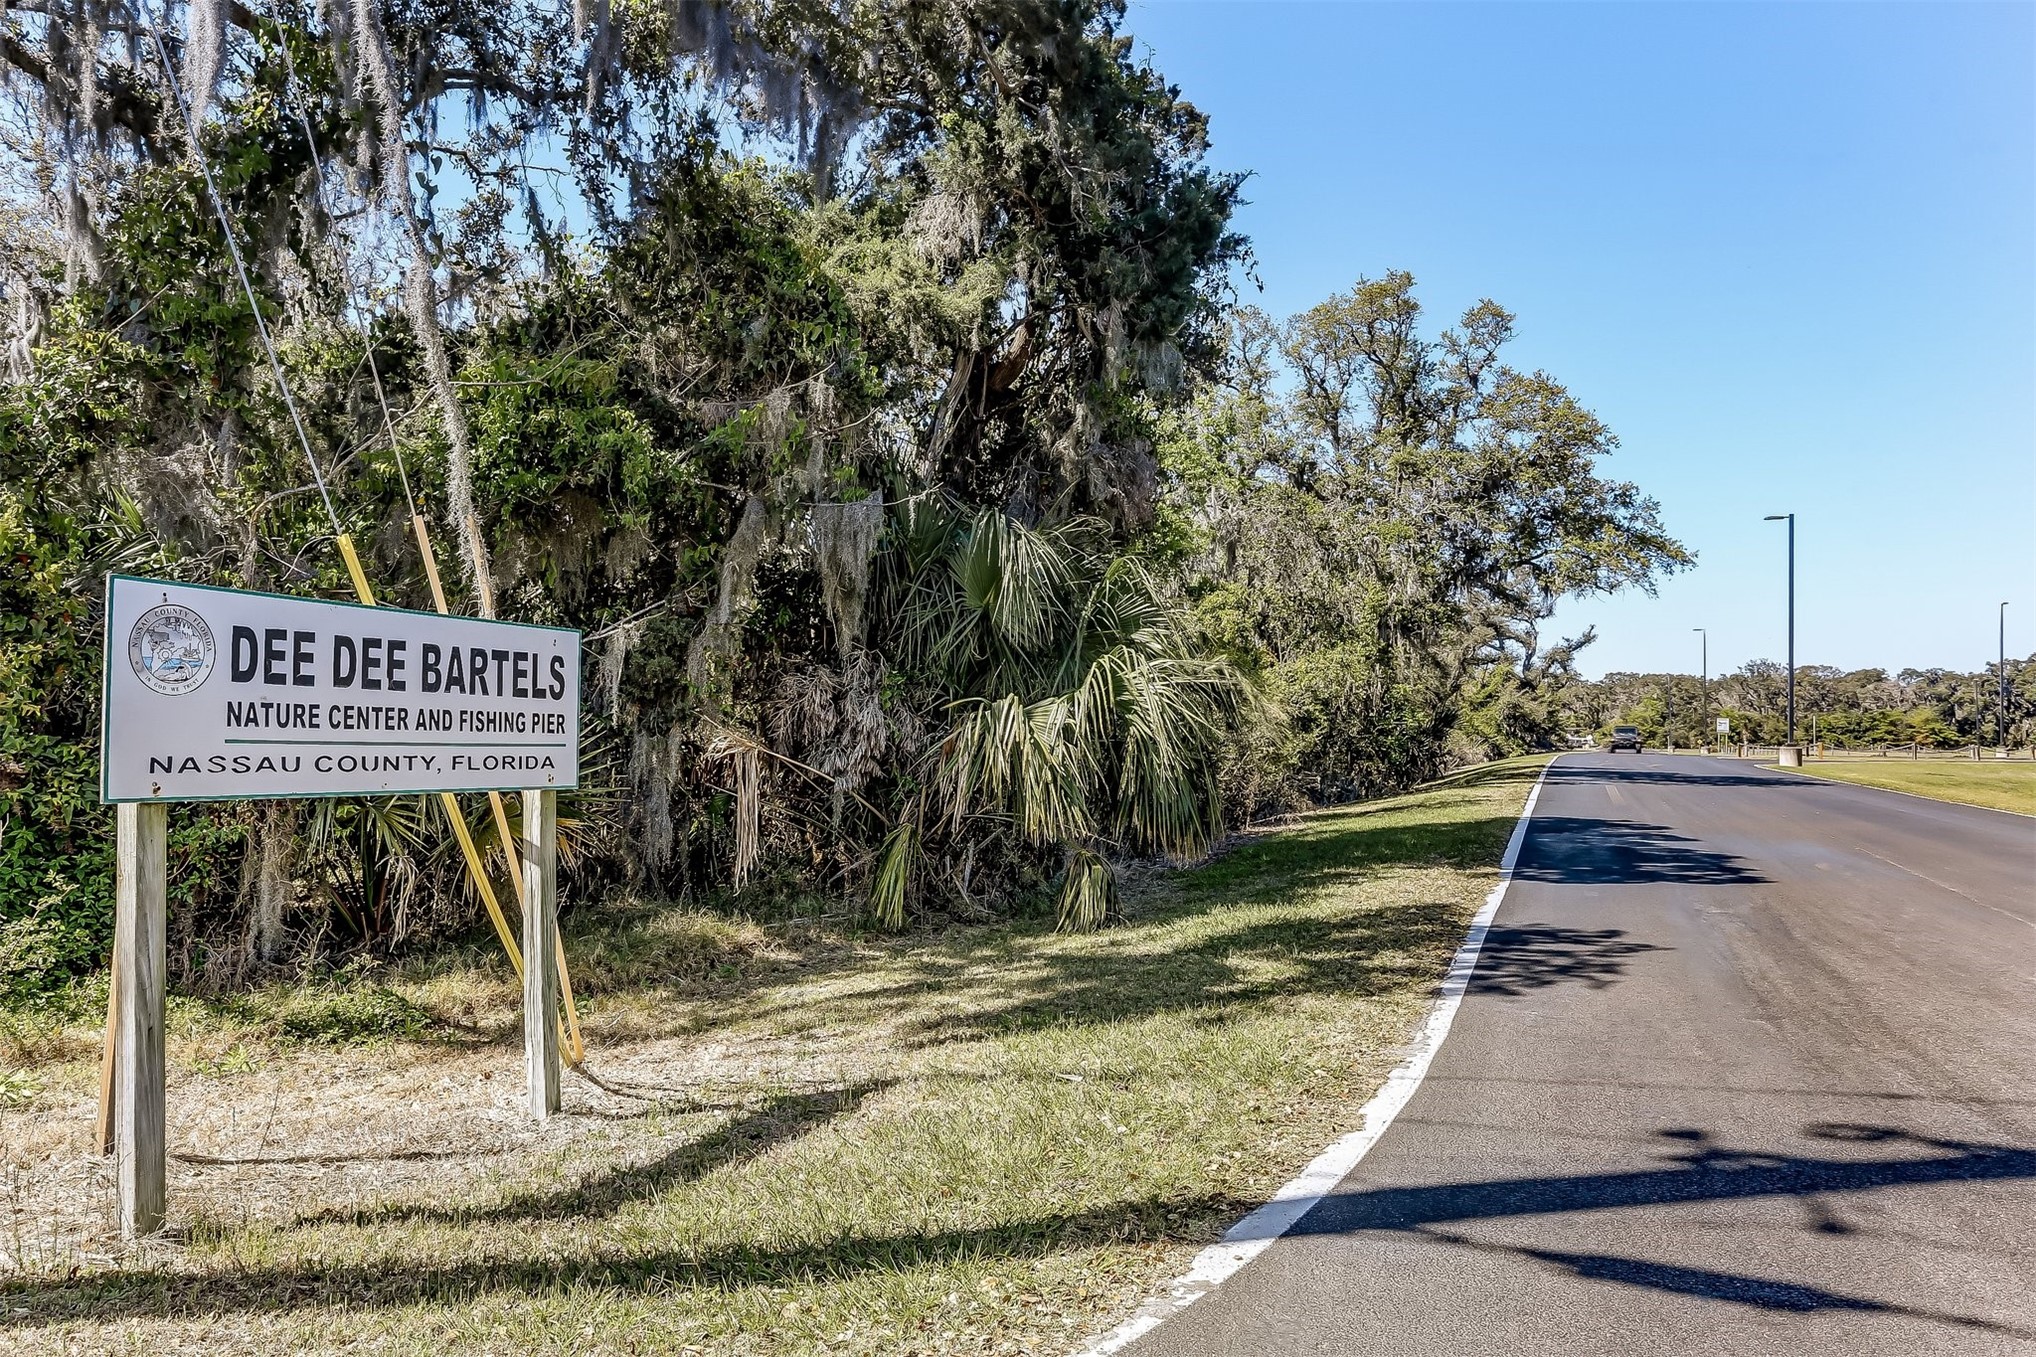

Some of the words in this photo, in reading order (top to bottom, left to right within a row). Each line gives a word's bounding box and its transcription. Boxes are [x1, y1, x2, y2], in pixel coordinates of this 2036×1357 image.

[131, 617, 150, 648] NASSAU
[154, 608, 189, 618] COUNTY
[192, 617, 212, 652] FLORIDA
[230, 625, 316, 687] DEE
[332, 634, 407, 692] DEE
[421, 642, 566, 701] BARTELS
[153, 682, 167, 691] GOD
[183, 678, 200, 690] TRUST
[226, 700, 321, 729] NATURE
[328, 704, 409, 731] CENTER
[415, 708, 453, 732] AND
[459, 709, 526, 734] FISHING
[531, 712, 566, 735] PIER
[149, 755, 301, 774] NASSAU
[314, 755, 442, 775] COUNTY,
[451, 755, 556, 771] FLORIDA
